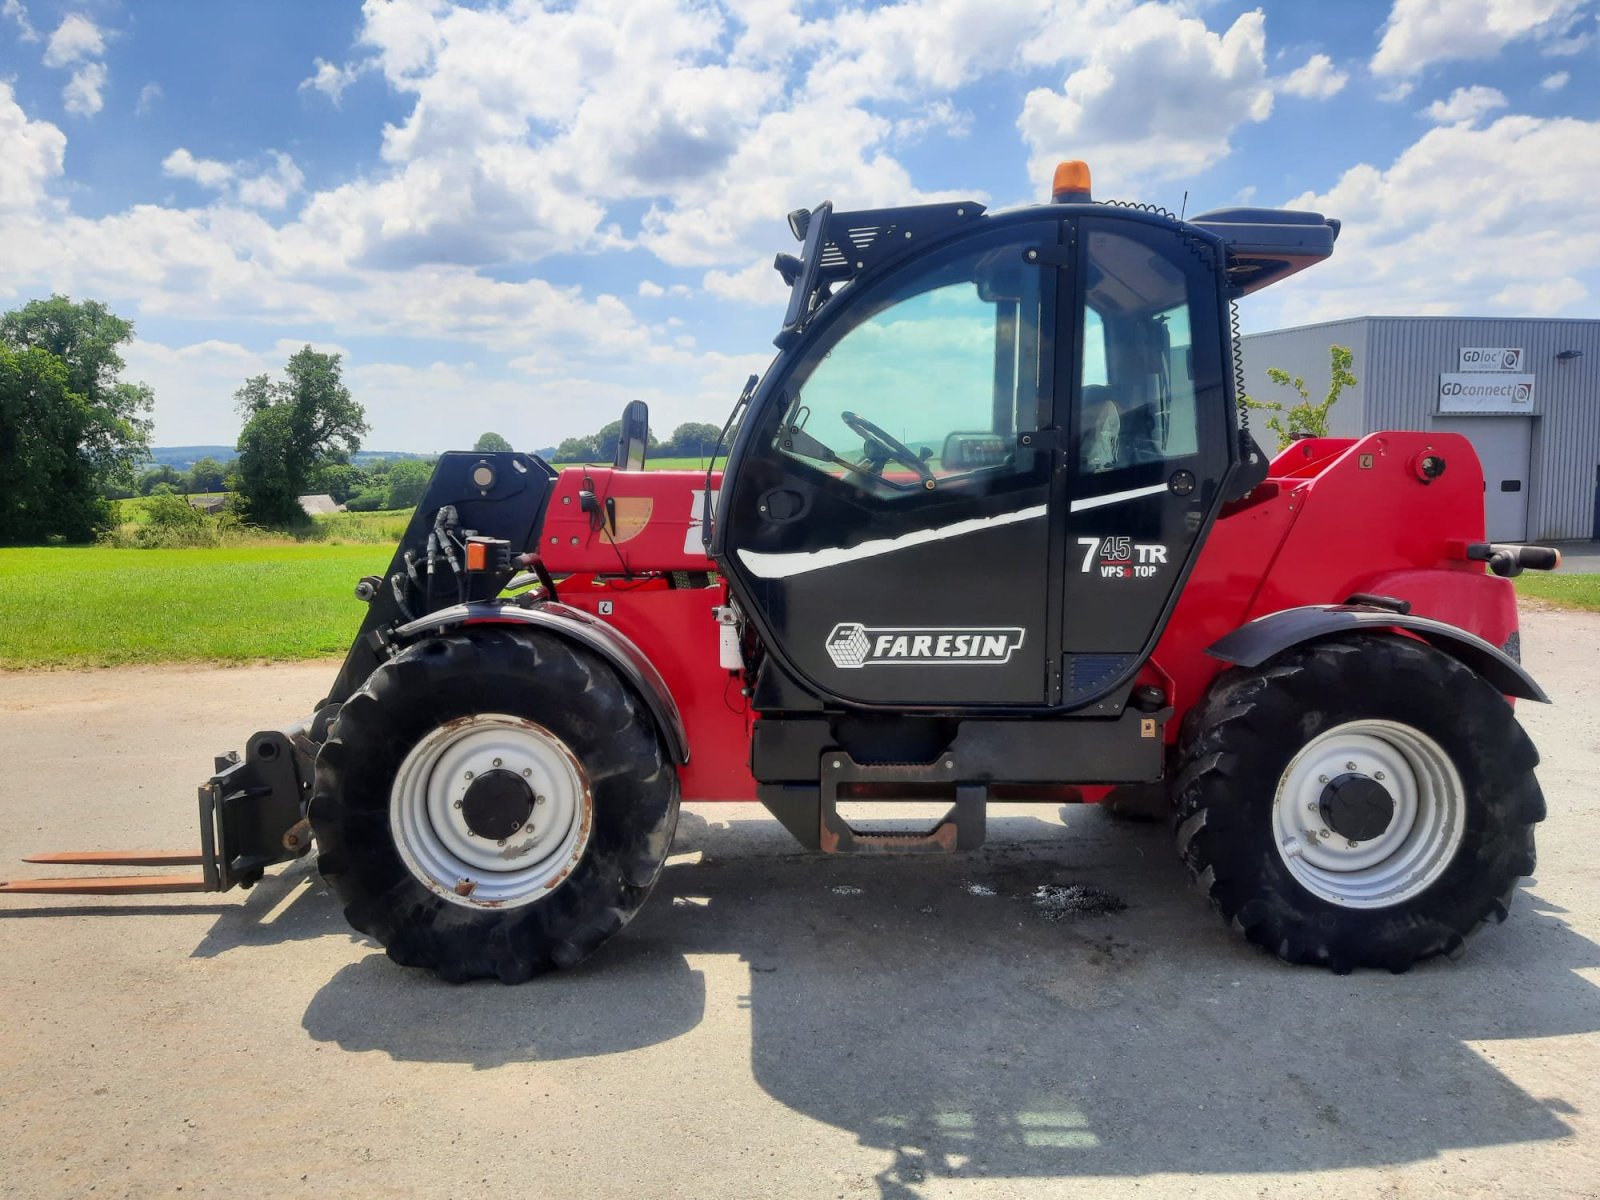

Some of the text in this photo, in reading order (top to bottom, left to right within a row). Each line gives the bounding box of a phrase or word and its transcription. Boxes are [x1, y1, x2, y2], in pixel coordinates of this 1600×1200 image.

[1441, 382, 1512, 396] GDconnect
[1134, 544, 1168, 564] TR
[1134, 565, 1157, 578] TOP
[873, 635, 1008, 657] FARESIN
